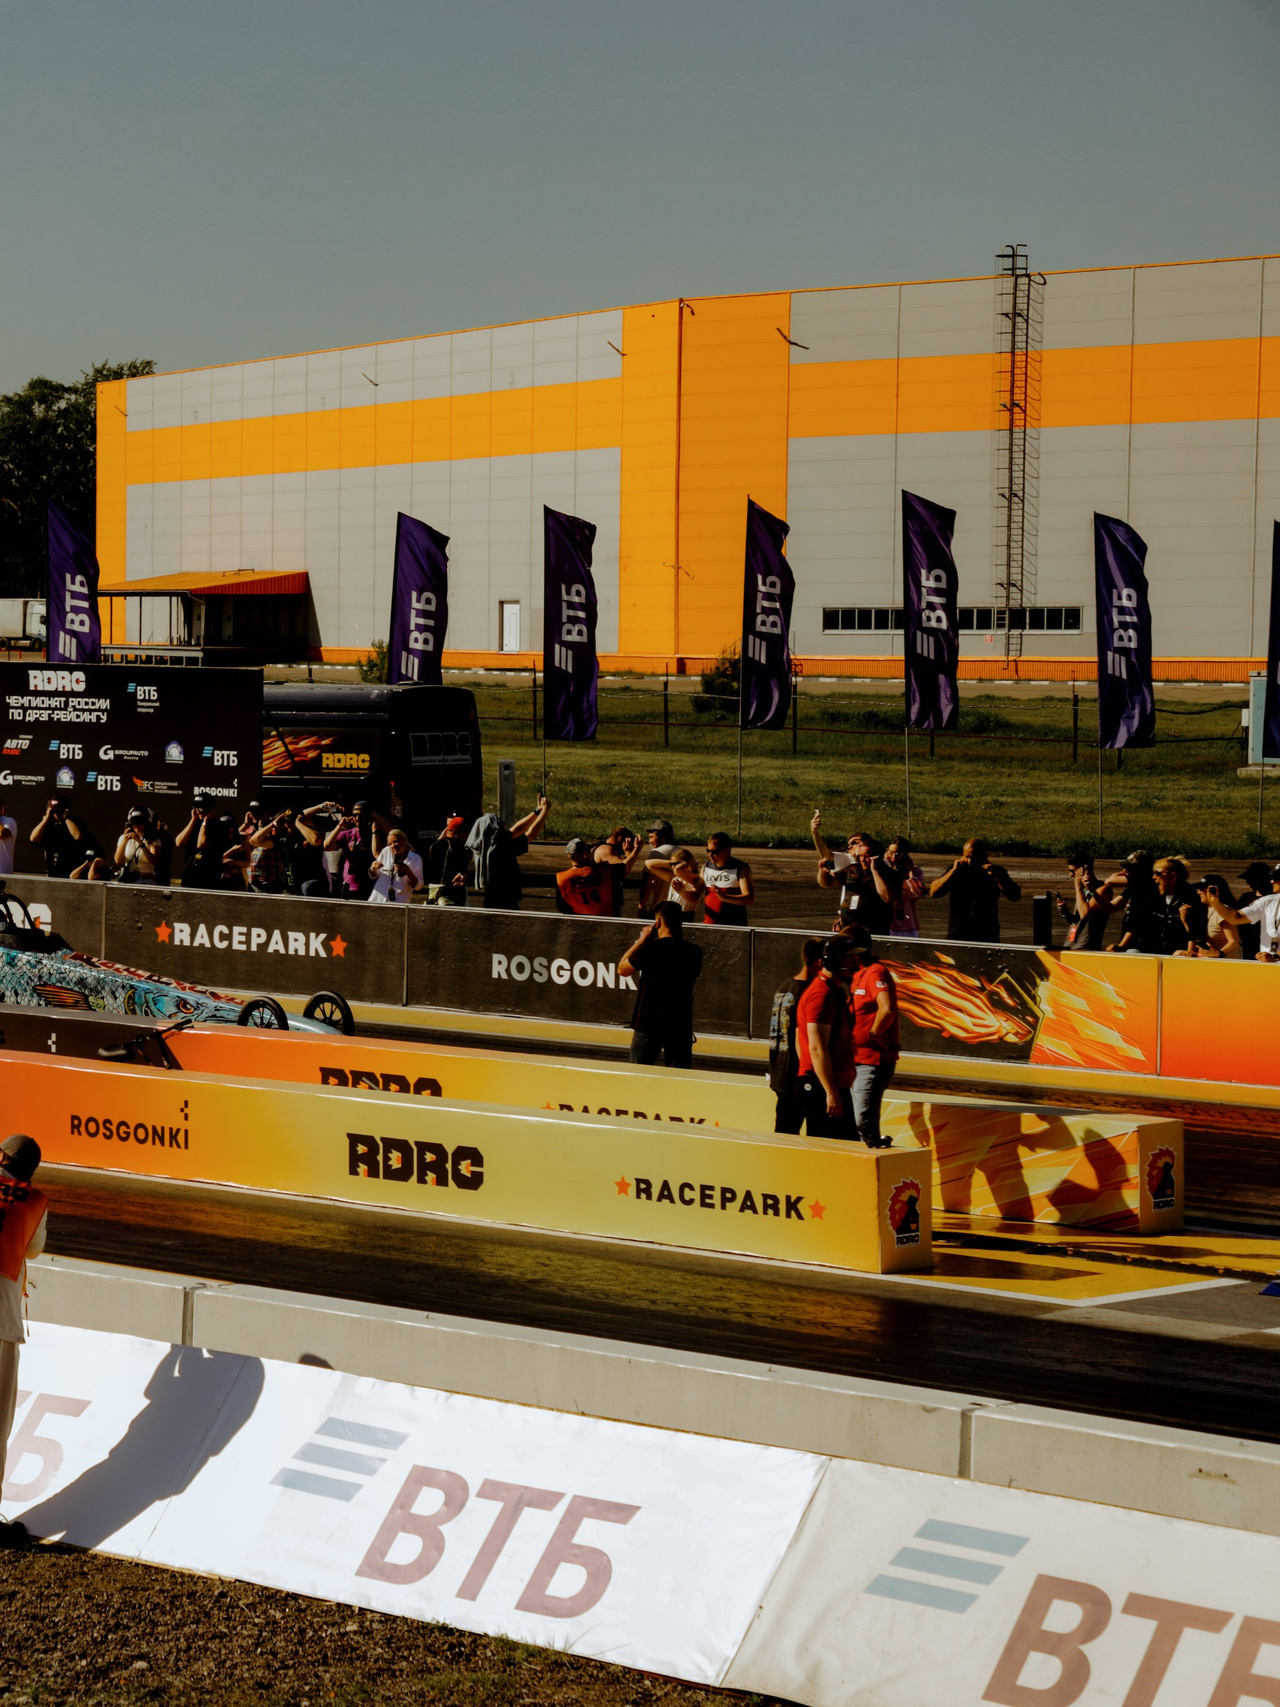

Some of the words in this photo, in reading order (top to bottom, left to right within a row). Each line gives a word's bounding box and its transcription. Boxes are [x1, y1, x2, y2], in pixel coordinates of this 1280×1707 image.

[64, 572, 90, 634] ВТБ
[561, 582, 588, 643] ВТБ
[755, 573, 782, 635] ВТБ
[921, 568, 948, 631] ВТБ
[408, 590, 436, 652] ВТБ
[1112, 587, 1140, 650] ВТБ
[28, 670, 86, 692] RDRC
[136, 686, 158, 700] ВТБ
[6, 696, 66, 710] ЧЕМПИОНАТ
[68, 698, 110, 711] РОССИИ
[9, 709, 23, 721] ПО
[25, 708, 108, 724] ДРЭГ-РЕЙСИНГУ
[4, 739, 30, 749] АВТО
[59, 744, 83, 760] ВТБ
[214, 750, 238, 766] ВТБ
[322, 752, 370, 768] RDRC
[97, 775, 122, 792] ВТБ
[173, 922, 328, 958] RACEPARK
[70, 1114, 189, 1150] ROSGONKI
[346, 1133, 484, 1191] RDRC
[634, 1177, 806, 1221] RACEPARK
[896, 1234, 920, 1246] RDRC
[356, 1464, 642, 1620] ВТБ
